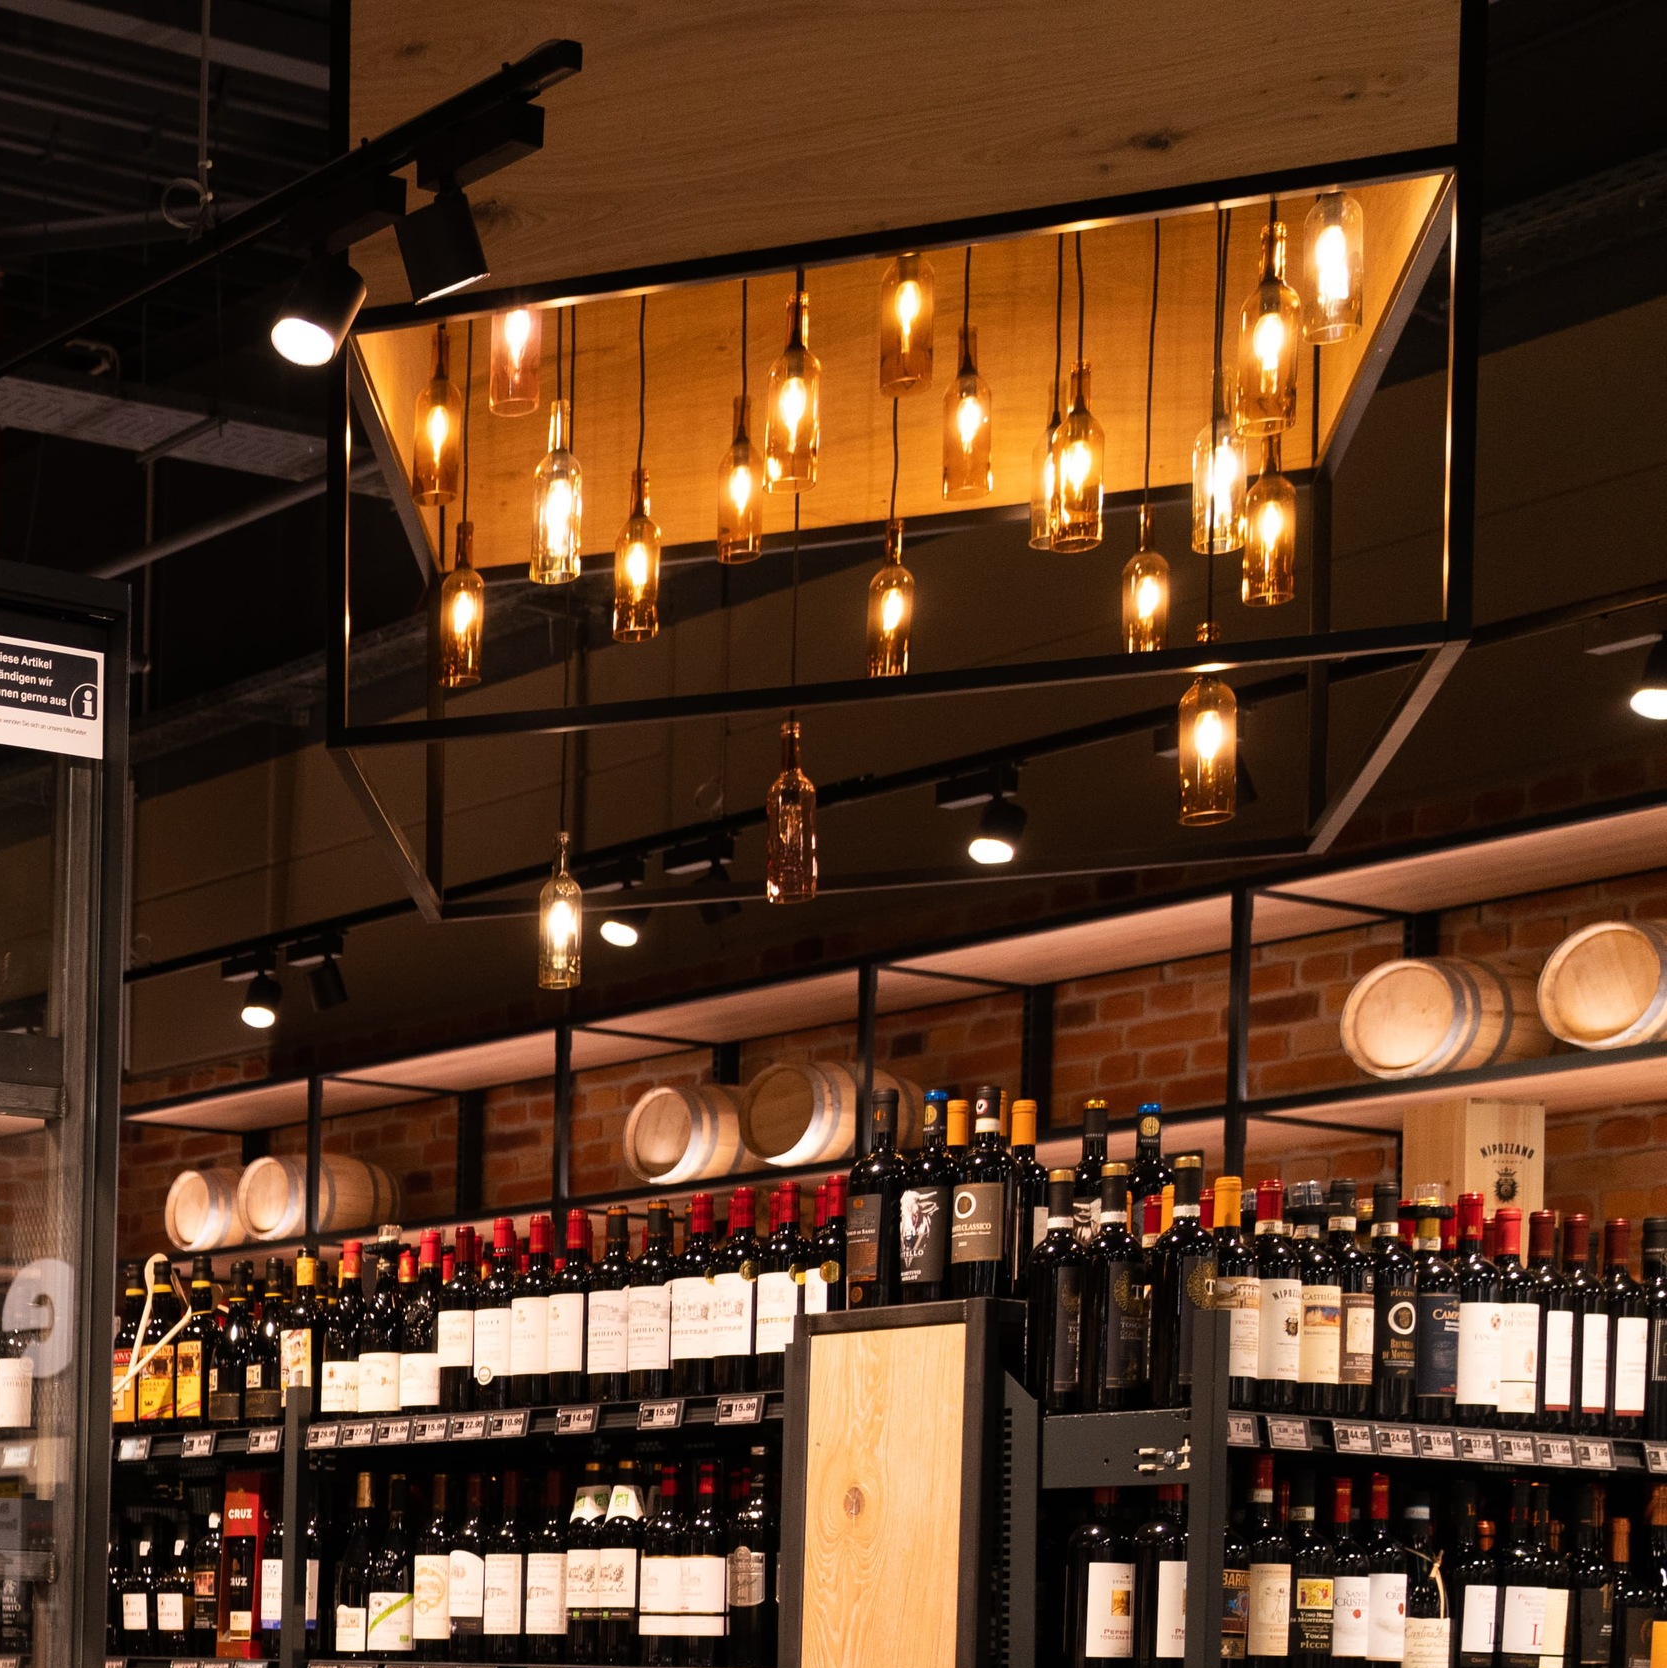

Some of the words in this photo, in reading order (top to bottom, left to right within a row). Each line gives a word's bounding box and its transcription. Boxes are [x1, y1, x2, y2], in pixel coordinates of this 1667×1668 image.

[21, 655, 52, 670] Artikel
[38, 676, 54, 687] wir
[20, 690, 48, 702] gerne
[49, 696, 67, 707] aus
[1480, 1142, 1535, 1160] NIPOZZANO
[961, 1222, 992, 1231] CLASSICO
[1272, 1287, 1302, 1302] NIPOZZ
[655, 1407, 677, 1417] 15.99
[734, 1402, 756, 1412] 15.99
[571, 1413, 592, 1423] 14.99
[390, 1425, 408, 1434] 19.99
[427, 1423, 445, 1432] 15.99
[464, 1420, 483, 1429] 22.95
[1349, 1430, 1370, 1441] 44.95
[1390, 1432, 1411, 1444] 24.95
[228, 1509, 253, 1519] CRUZ
